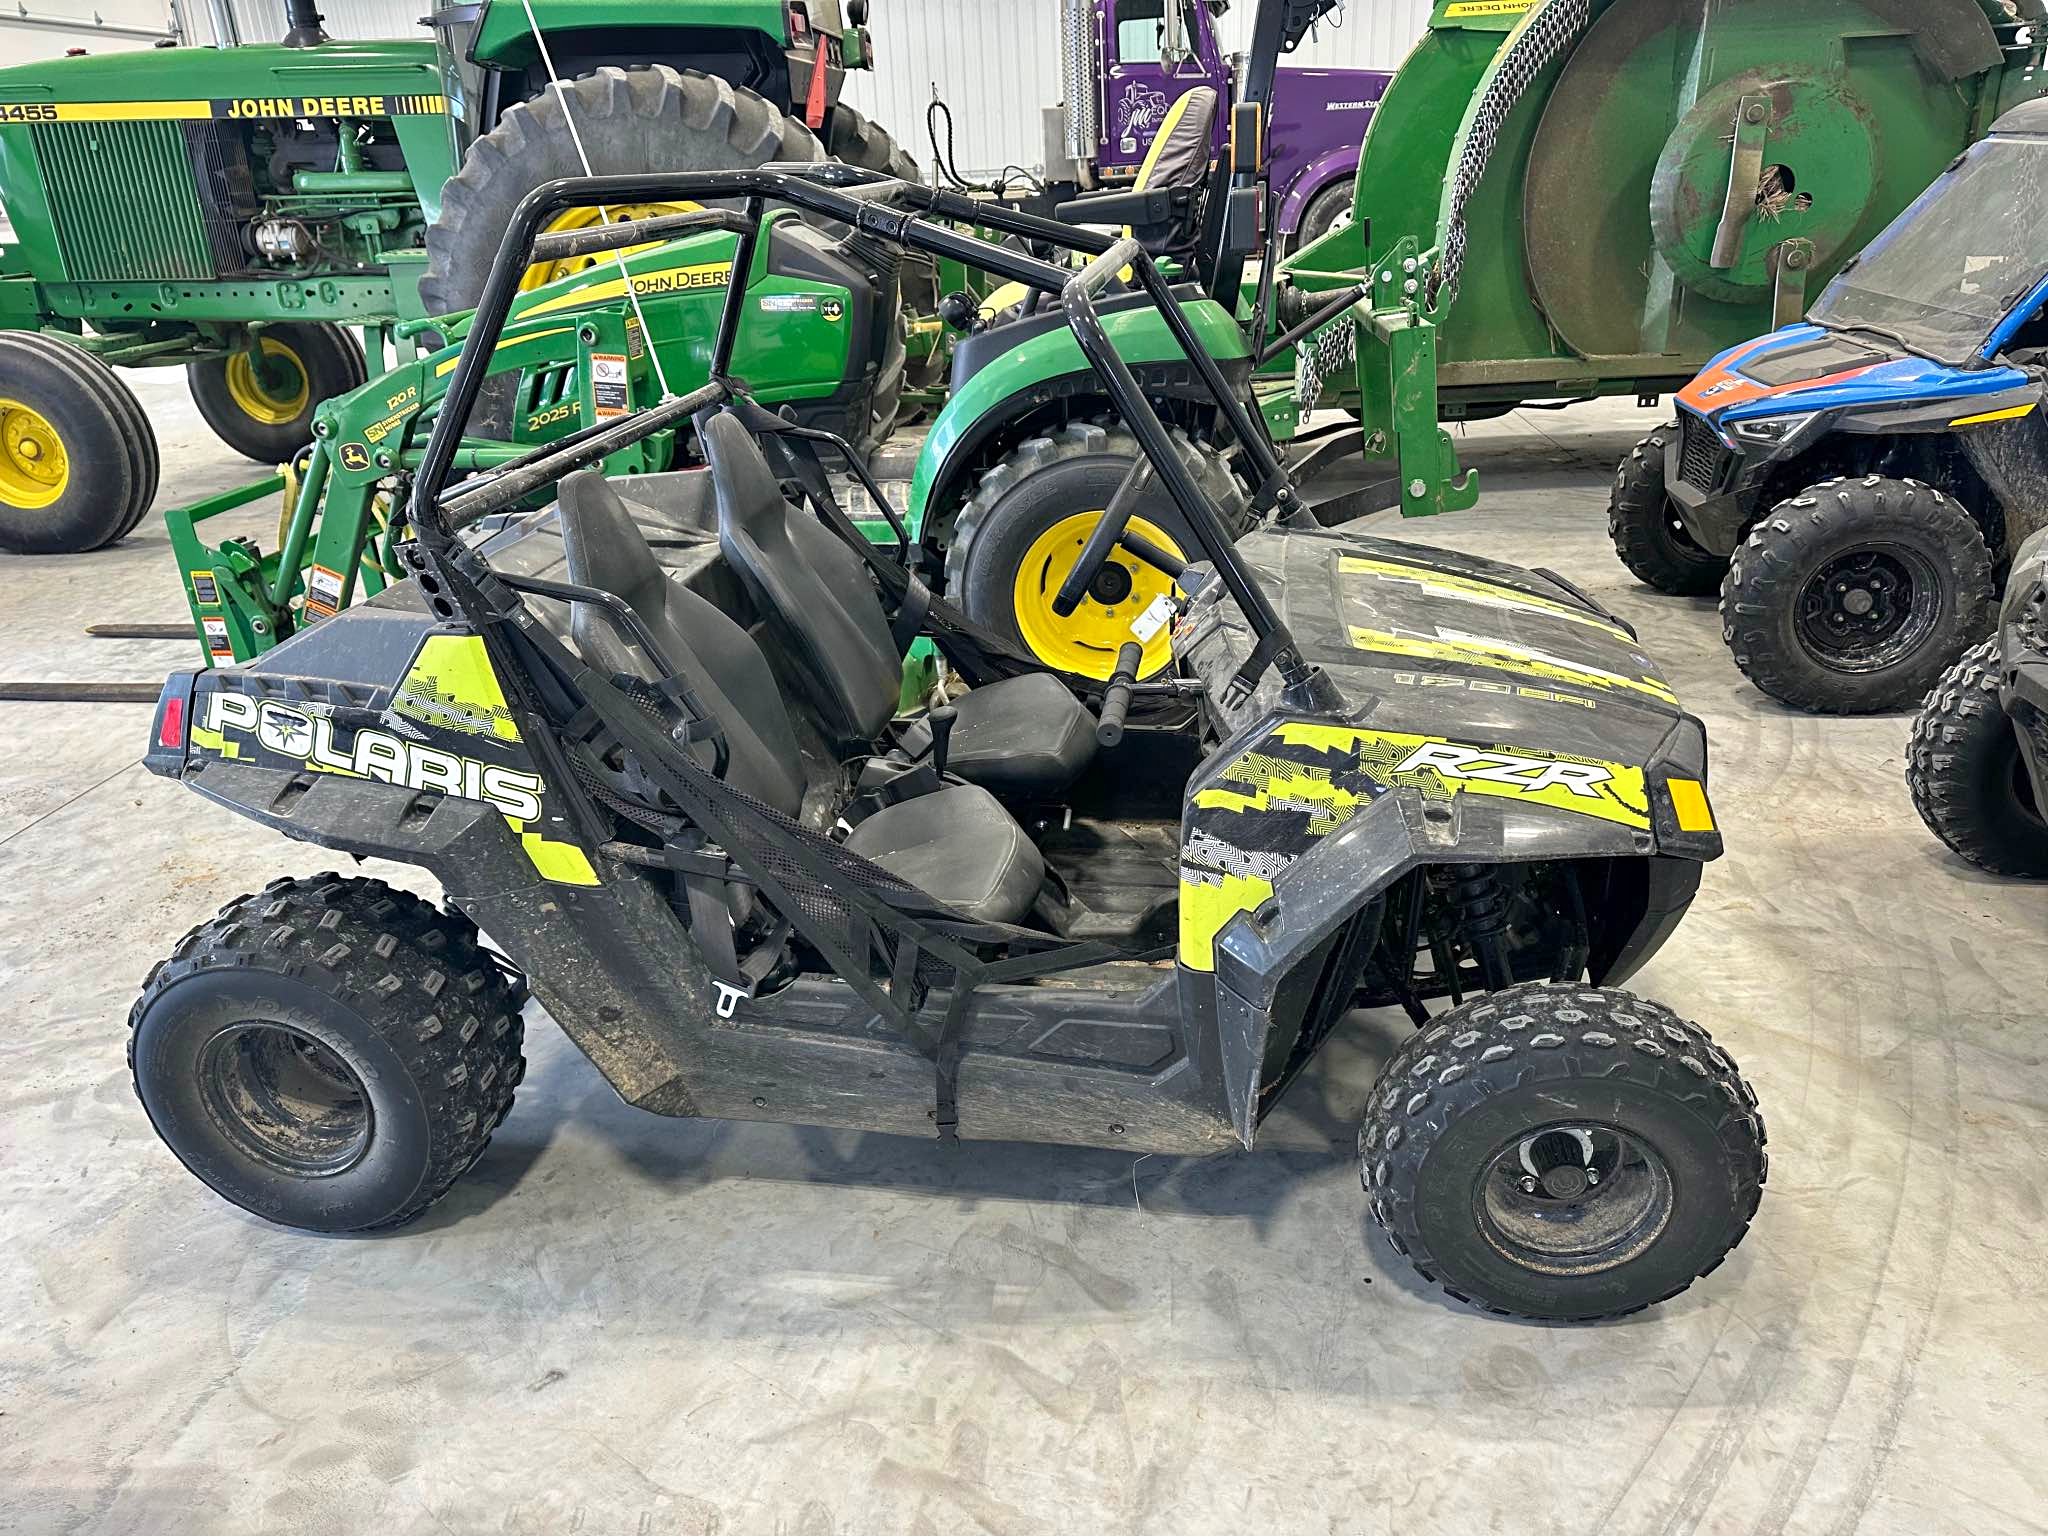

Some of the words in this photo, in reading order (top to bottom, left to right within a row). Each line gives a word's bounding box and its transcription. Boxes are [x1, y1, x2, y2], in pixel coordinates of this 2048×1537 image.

[227, 98, 294, 118] JOHN
[303, 96, 385, 115] DEERE
[624, 275, 671, 295] JOHN
[598, 354, 625, 362] WARNING
[386, 391, 407, 411] 120
[407, 386, 417, 398] R
[528, 405, 569, 432] 2025
[207, 691, 542, 823] POLARIS
[1388, 741, 1615, 800] RZR
